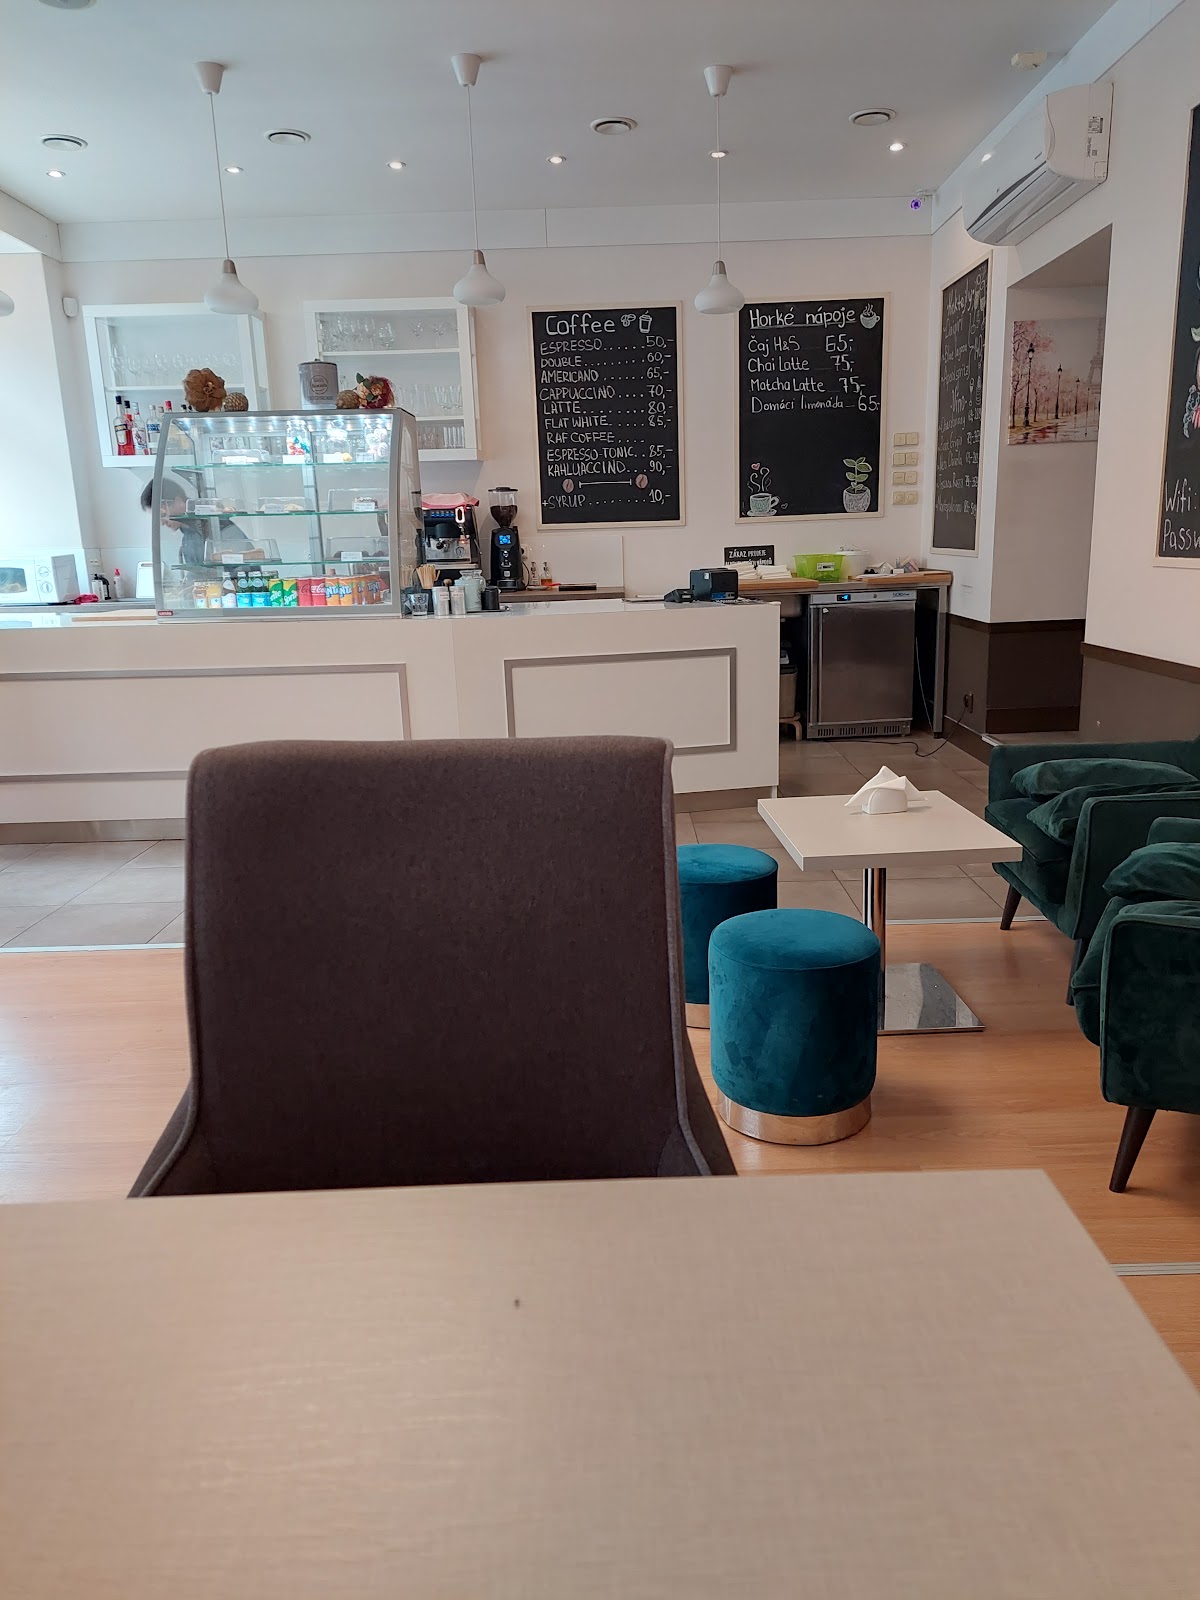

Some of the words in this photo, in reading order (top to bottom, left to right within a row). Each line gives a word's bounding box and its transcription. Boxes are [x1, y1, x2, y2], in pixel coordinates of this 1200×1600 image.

[545, 312, 616, 336] Coffee
[749, 307, 795, 328] Horké
[805, 306, 856, 328] nápoje
[540, 338, 603, 356] ESPRESSO
[646, 335, 675, 349] 50,-
[748, 335, 770, 357] Čaj
[773, 335, 800, 352] H&S
[540, 355, 582, 369] DOUBLE
[647, 351, 672, 364] 60,-
[747, 357, 776, 373] Chai
[778, 355, 810, 372] Latte
[829, 354, 855, 373] 75,-
[540, 368, 600, 384] AMERICANO
[646, 366, 670, 380] 65,-
[539, 385, 616, 401] CAPPUCCINO
[646, 384, 673, 399] 70,-
[750, 377, 792, 392] Matcha
[792, 377, 826, 393] Latte
[838, 376, 867, 396] 75,-
[543, 401, 581, 415] LATTE
[648, 401, 674, 415] 80,-
[800, 394, 844, 411] limonáda
[544, 418, 570, 430] FLAT
[572, 415, 608, 429] WHITE
[648, 414, 672, 428] 85,-
[546, 432, 569, 444] RAF
[570, 431, 616, 444] COFFEE
[546, 446, 634, 461] ESPRESSO-TONIC
[649, 444, 674, 459] 85,-
[547, 460, 627, 477] KAHLUACCINO
[649, 459, 673, 475] 90,-
[649, 489, 672, 504] 10,-
[1165, 478, 1197, 513] Wifi:
[729, 549, 747, 559] ZÁKAZ
